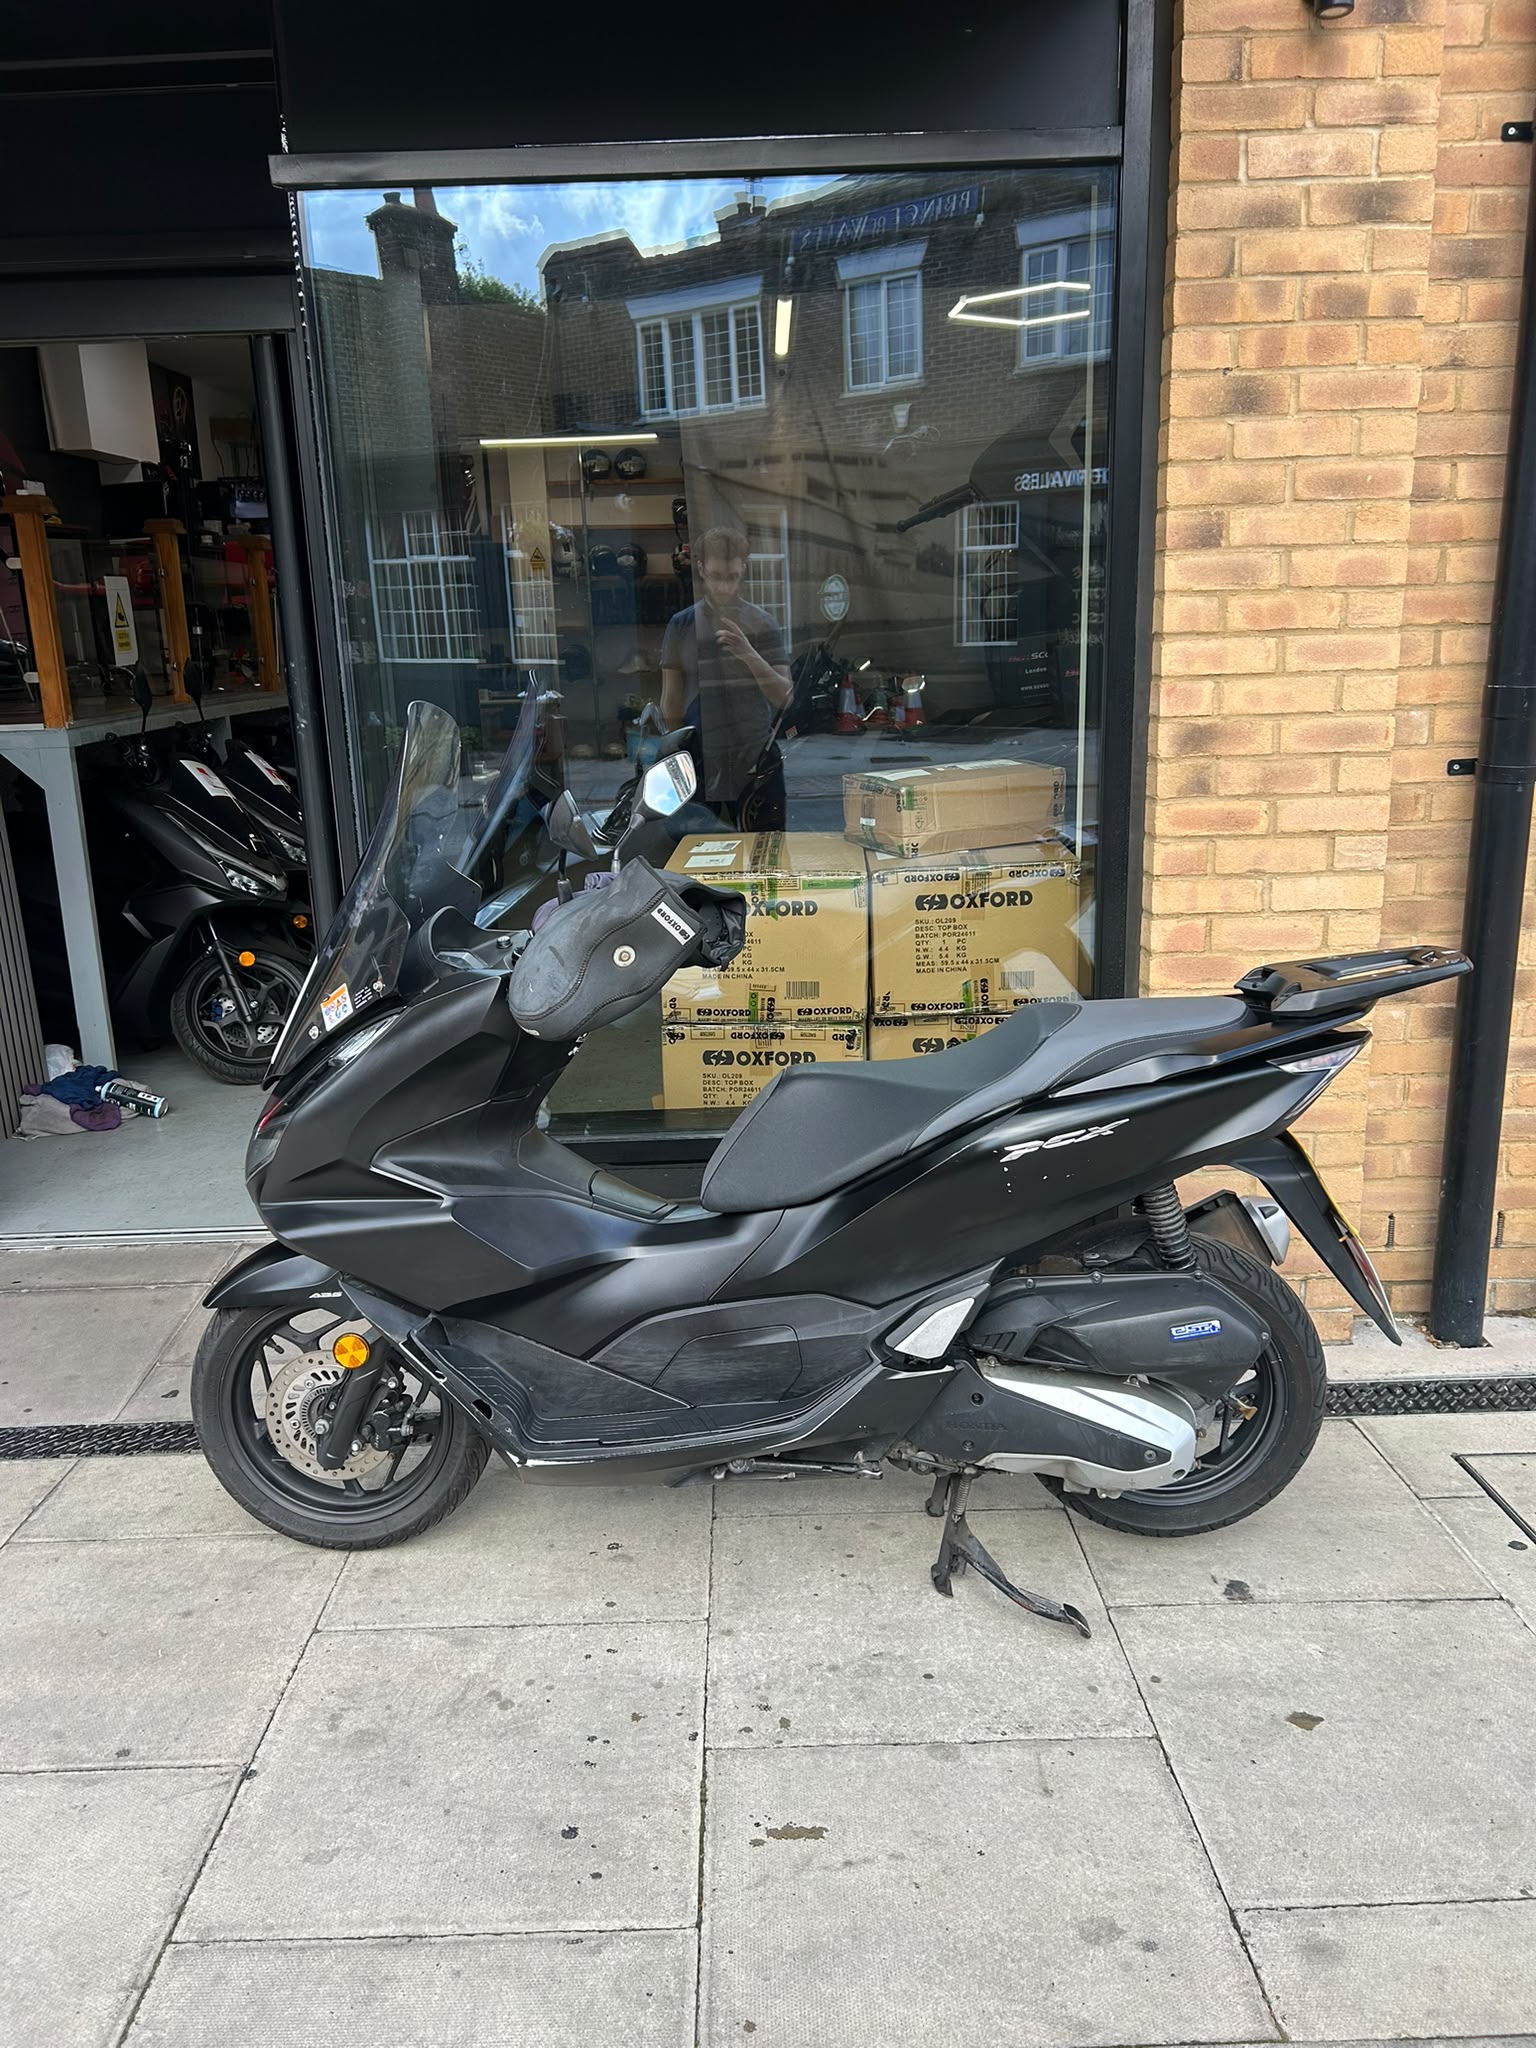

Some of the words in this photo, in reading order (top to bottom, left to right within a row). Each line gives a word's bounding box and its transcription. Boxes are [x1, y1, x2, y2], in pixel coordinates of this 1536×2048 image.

[904, 873, 943, 883] OXFORD
[950, 890, 1033, 910] OXFORD
[746, 900, 818, 917] XFORD
[656, 908, 682, 931] OXFORD
[814, 1007, 852, 1016] OXFORD
[927, 1002, 966, 1011] OXFORD
[736, 1051, 816, 1067] OXFORD
[308, 1291, 343, 1299] ABS
